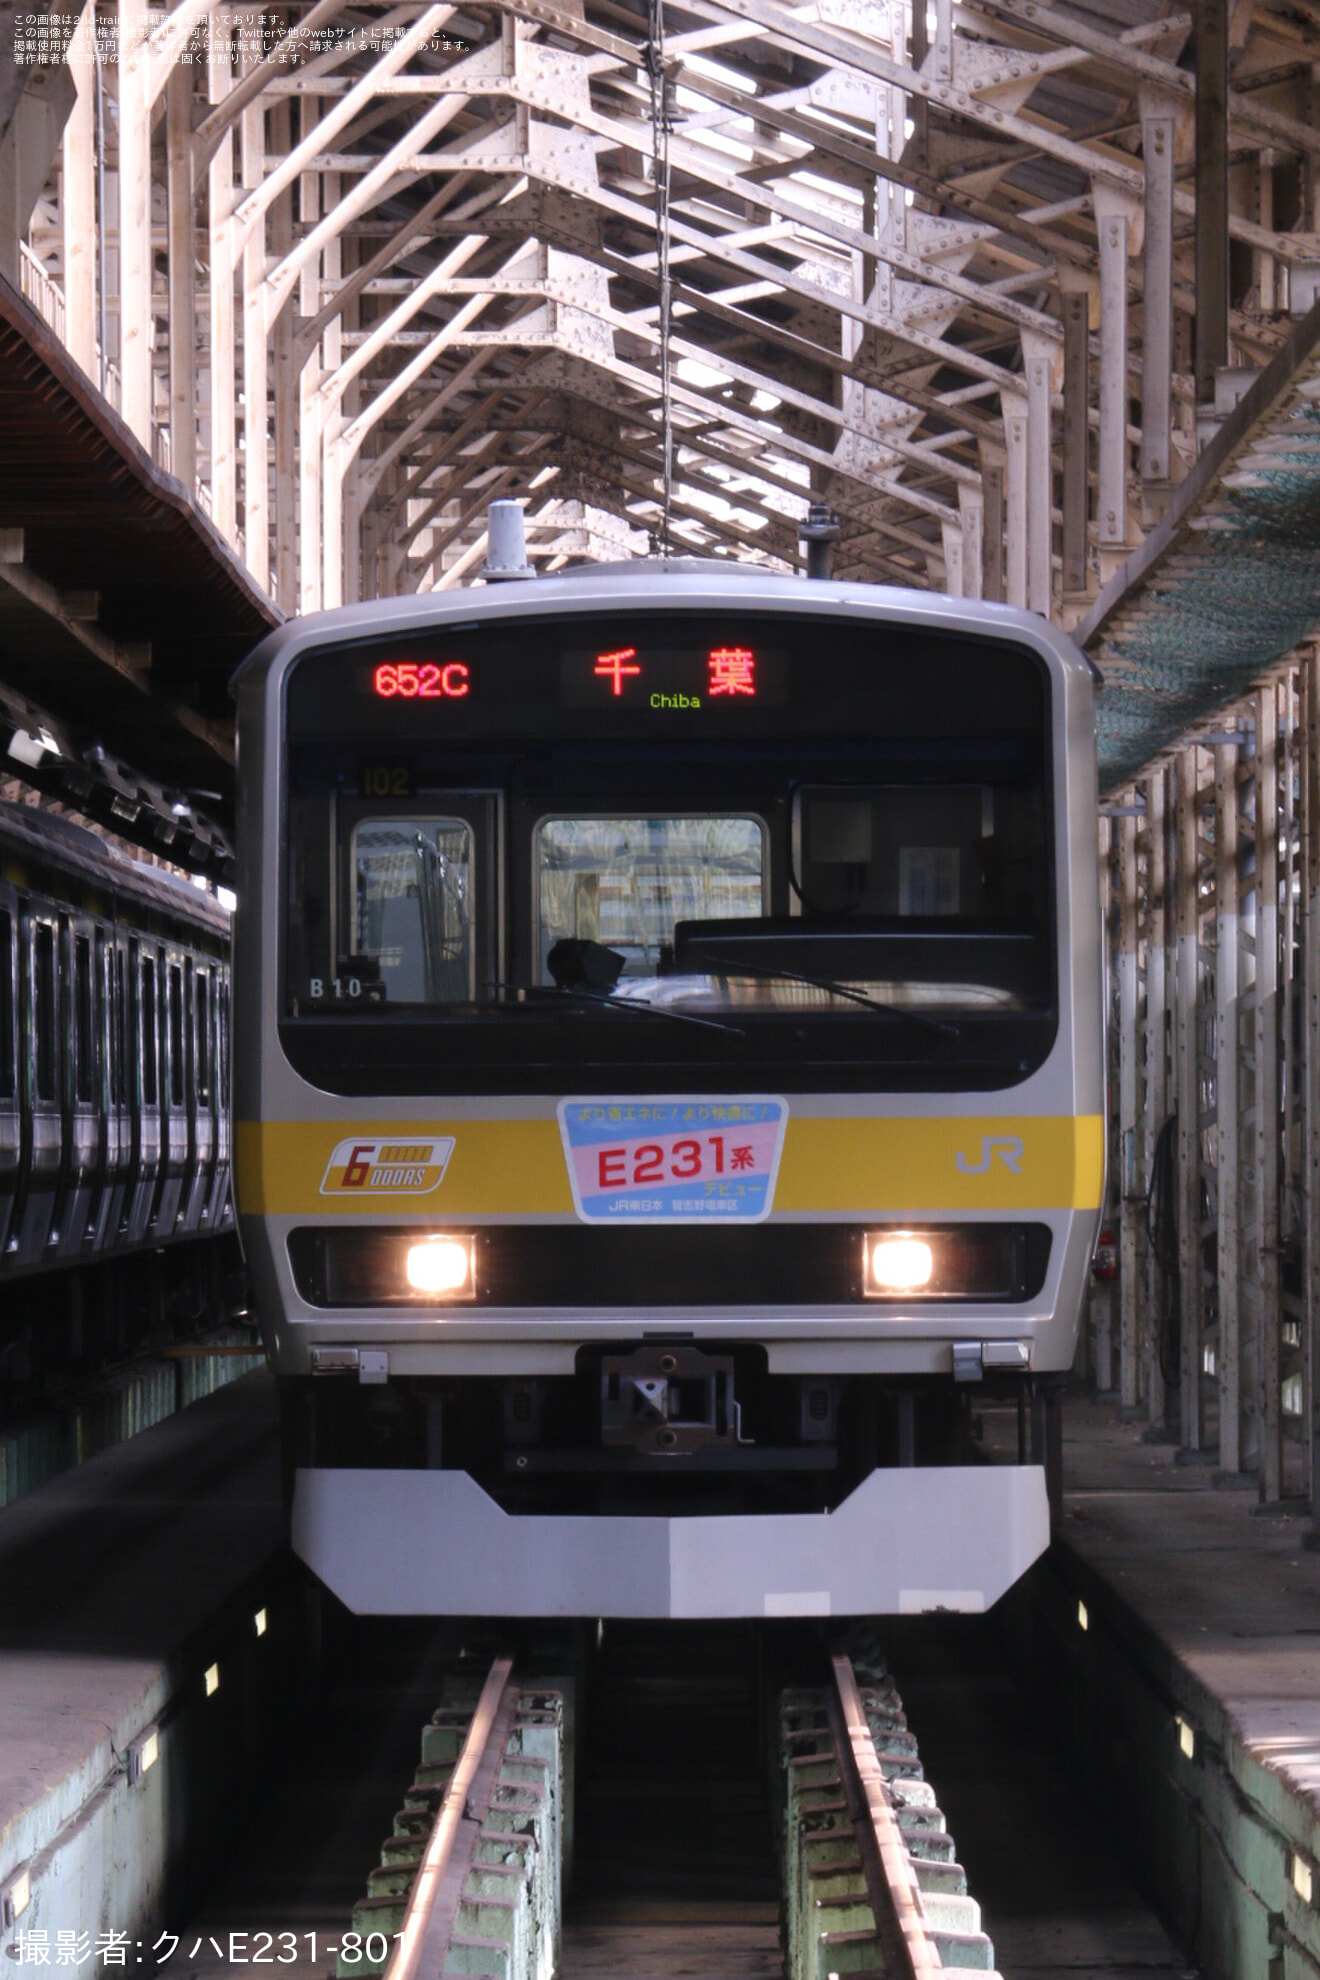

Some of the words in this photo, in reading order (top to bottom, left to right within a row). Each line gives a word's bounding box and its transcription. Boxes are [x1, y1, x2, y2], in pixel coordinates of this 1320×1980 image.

[375, 664, 468, 696] 652C
[650, 694, 700, 708] Chiba
[363, 767, 409, 796] 102
[341, 1145, 376, 1186] 6
[370, 1168, 425, 1186] DOORS
[598, 1136, 755, 1188] E231系
[955, 1136, 1024, 1174] JR
[704, 1182, 761, 1196] デビュー
[608, 1199, 663, 1212] JR東日本
